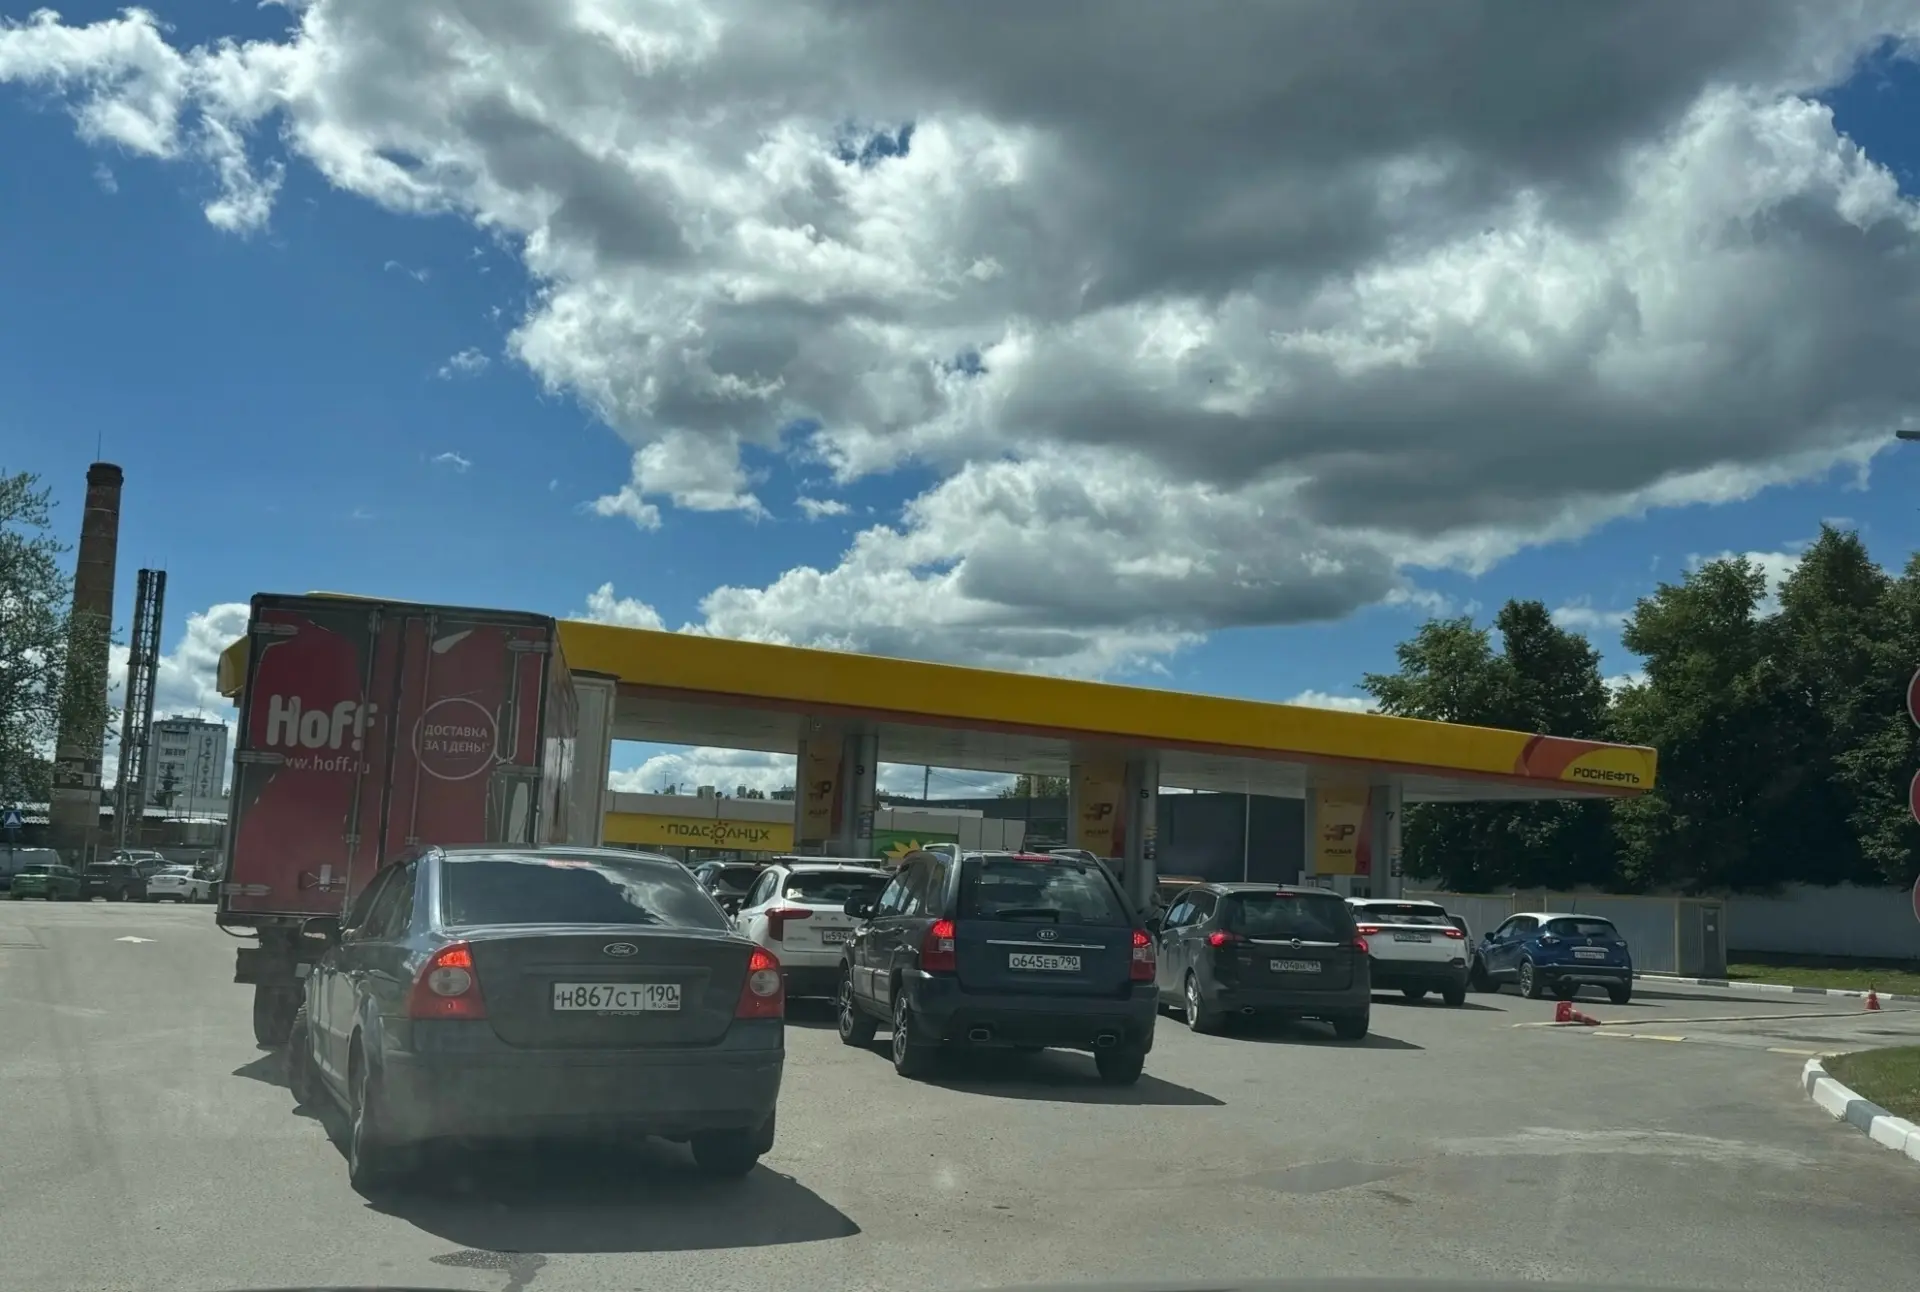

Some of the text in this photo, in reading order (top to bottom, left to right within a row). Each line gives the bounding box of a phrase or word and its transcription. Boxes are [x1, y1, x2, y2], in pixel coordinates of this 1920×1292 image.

[266, 694, 378, 751] Hoff
[424, 724, 488, 738] ДОСТАВКА
[424, 739, 439, 751] ЗА
[442, 740, 448, 751] 1
[285, 754, 371, 775] ww.hoff.ru
[855, 764, 865, 775] 3
[1573, 767, 1640, 784] РОСНЕФТЬ
[1140, 788, 1149, 799] 5
[1385, 811, 1395, 821] 7
[667, 822, 770, 843] ПОДСОЛНУХ
[1059, 956, 1078, 966] 790
[646, 985, 675, 1002] 190
